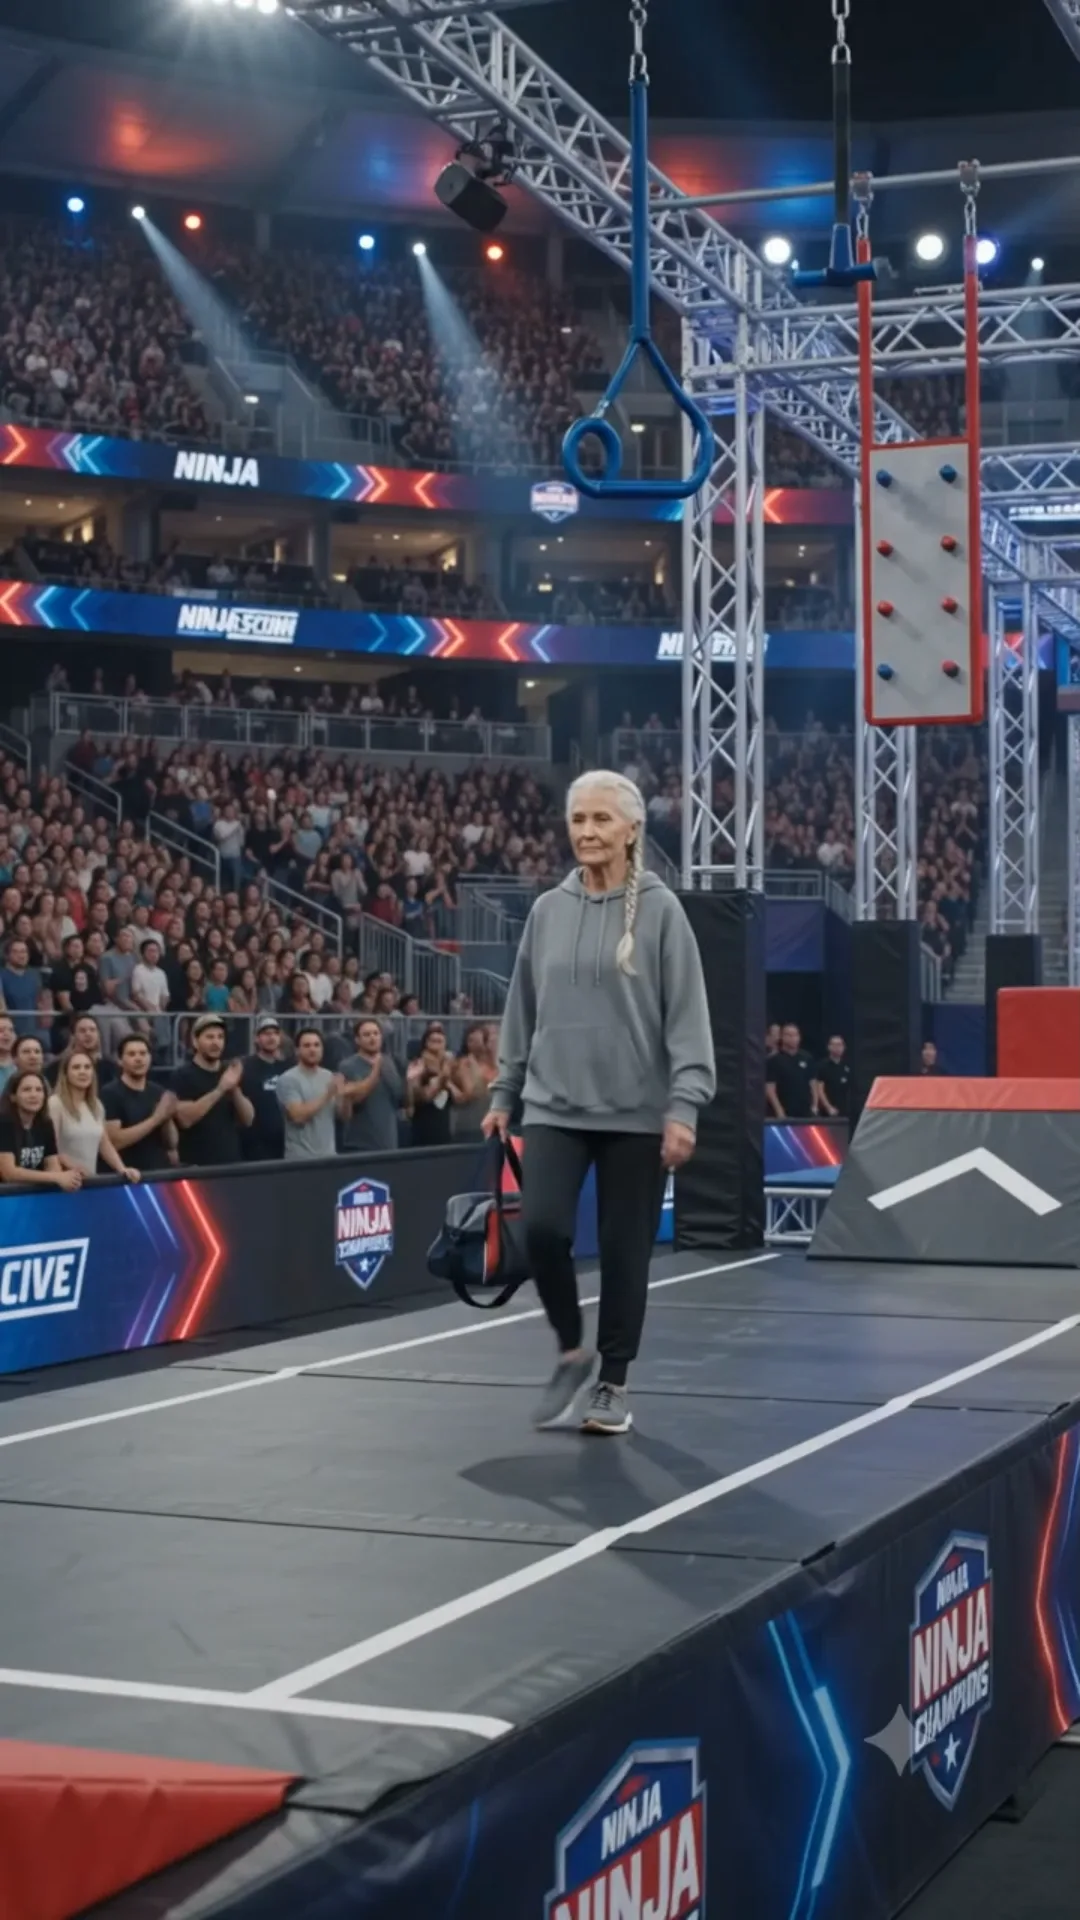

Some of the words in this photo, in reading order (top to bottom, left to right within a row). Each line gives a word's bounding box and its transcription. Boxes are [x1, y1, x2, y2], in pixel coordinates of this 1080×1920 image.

[173, 450, 259, 487] NINJA
[338, 1204, 391, 1240] NINJA
[1, 1253, 75, 1306] CIVE
[914, 1587, 989, 1709] NINJA
[601, 1780, 662, 1861] NINJA
[554, 1811, 700, 1920] NJA
